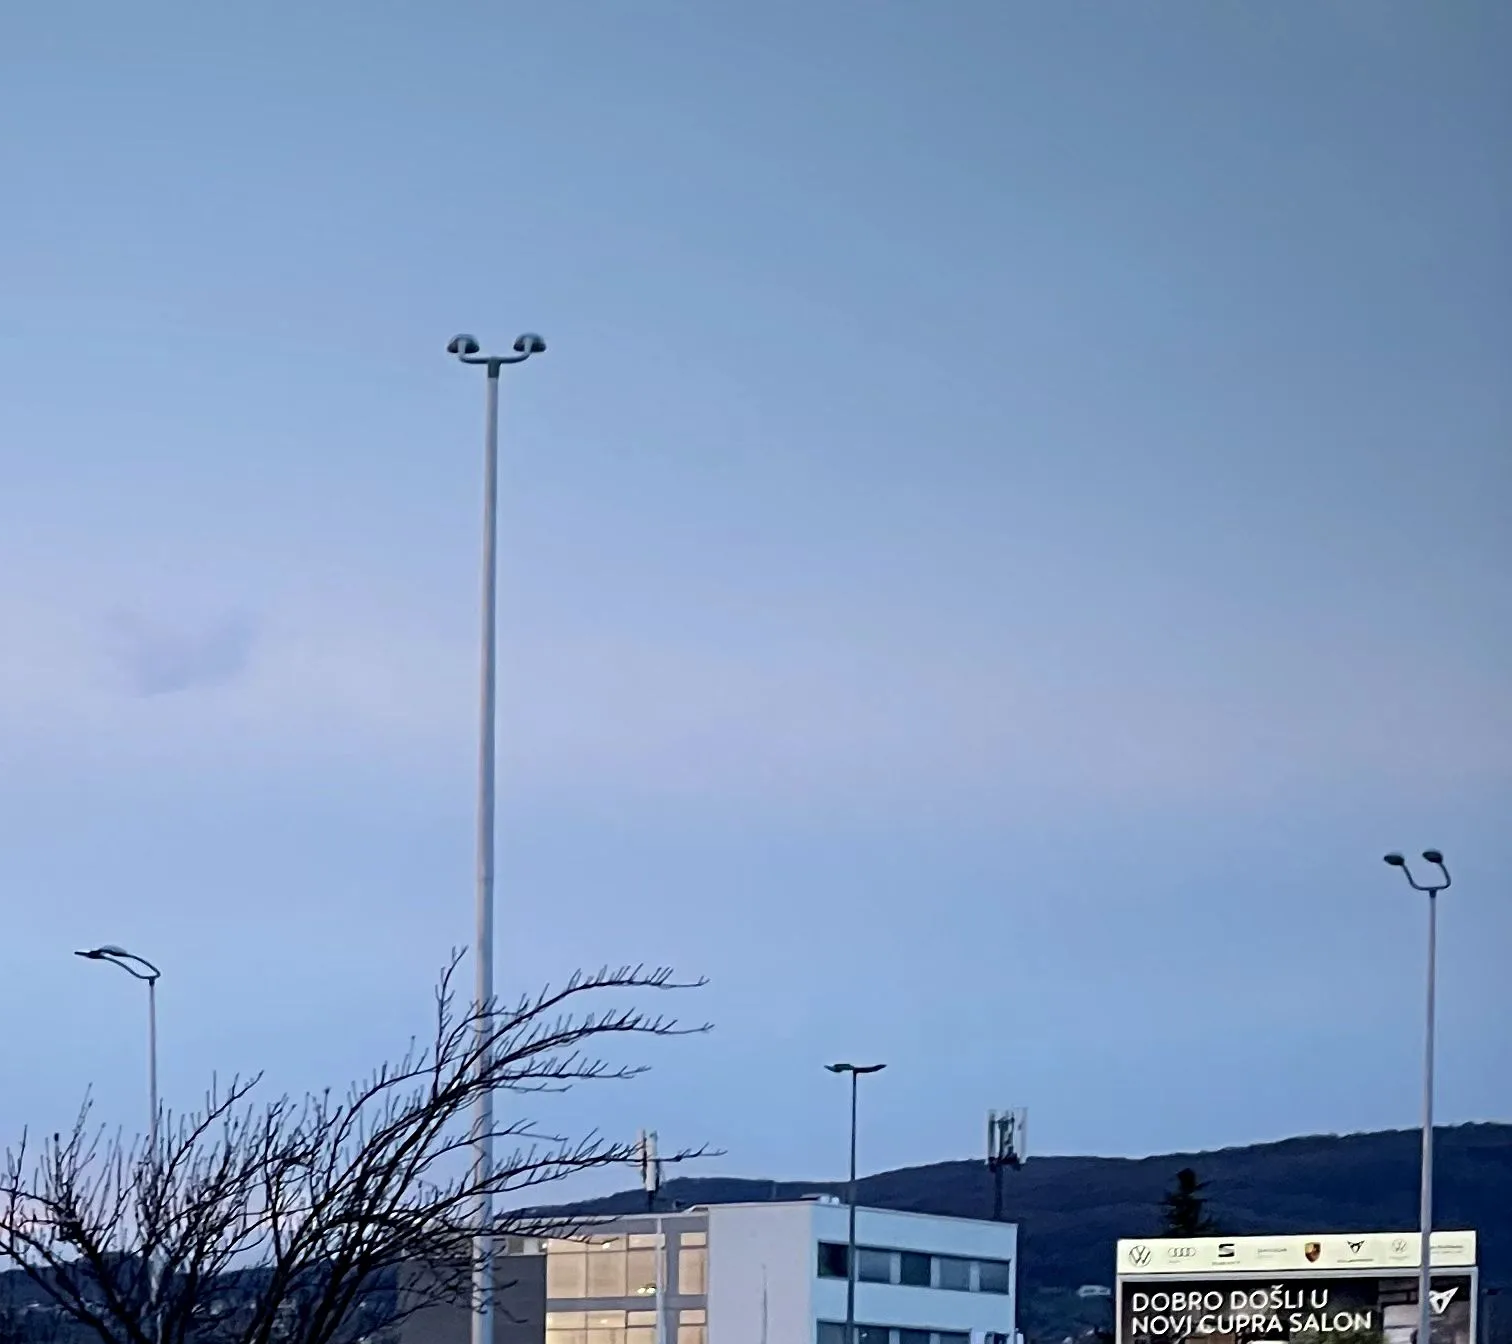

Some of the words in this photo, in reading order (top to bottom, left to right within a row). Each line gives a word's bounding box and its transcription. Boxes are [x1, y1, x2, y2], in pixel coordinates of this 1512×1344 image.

[1132, 1290, 1223, 1312] DOBRO
[1230, 1284, 1304, 1310] DOŠLI
[1311, 1288, 1328, 1309] U
[1132, 1314, 1192, 1335] NOVI
[1199, 1313, 1284, 1334] CUPRA
[1289, 1311, 1371, 1333] SALON
